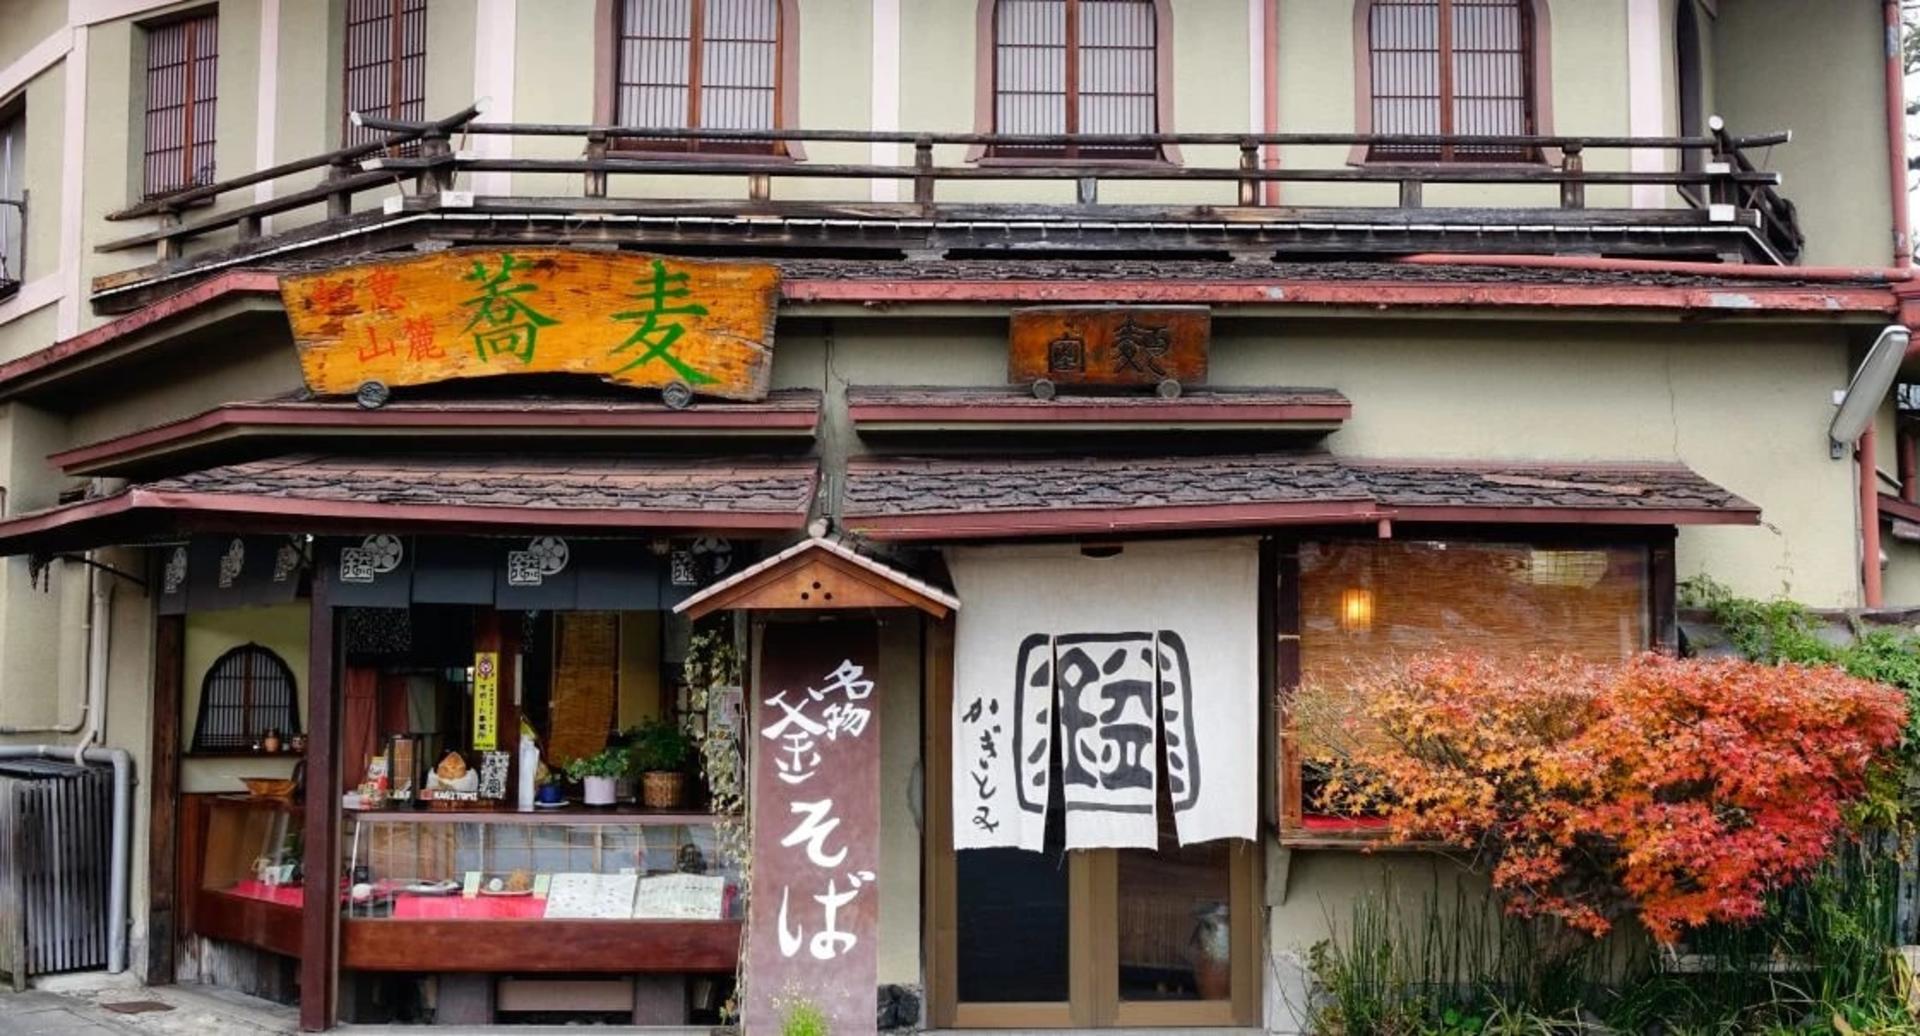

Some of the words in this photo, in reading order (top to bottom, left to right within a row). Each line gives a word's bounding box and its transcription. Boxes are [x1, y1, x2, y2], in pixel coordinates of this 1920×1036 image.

[462, 255, 720, 384] 蕎麦
[821, 658, 875, 741] 名物
[962, 698, 1001, 832] かぎとみ
